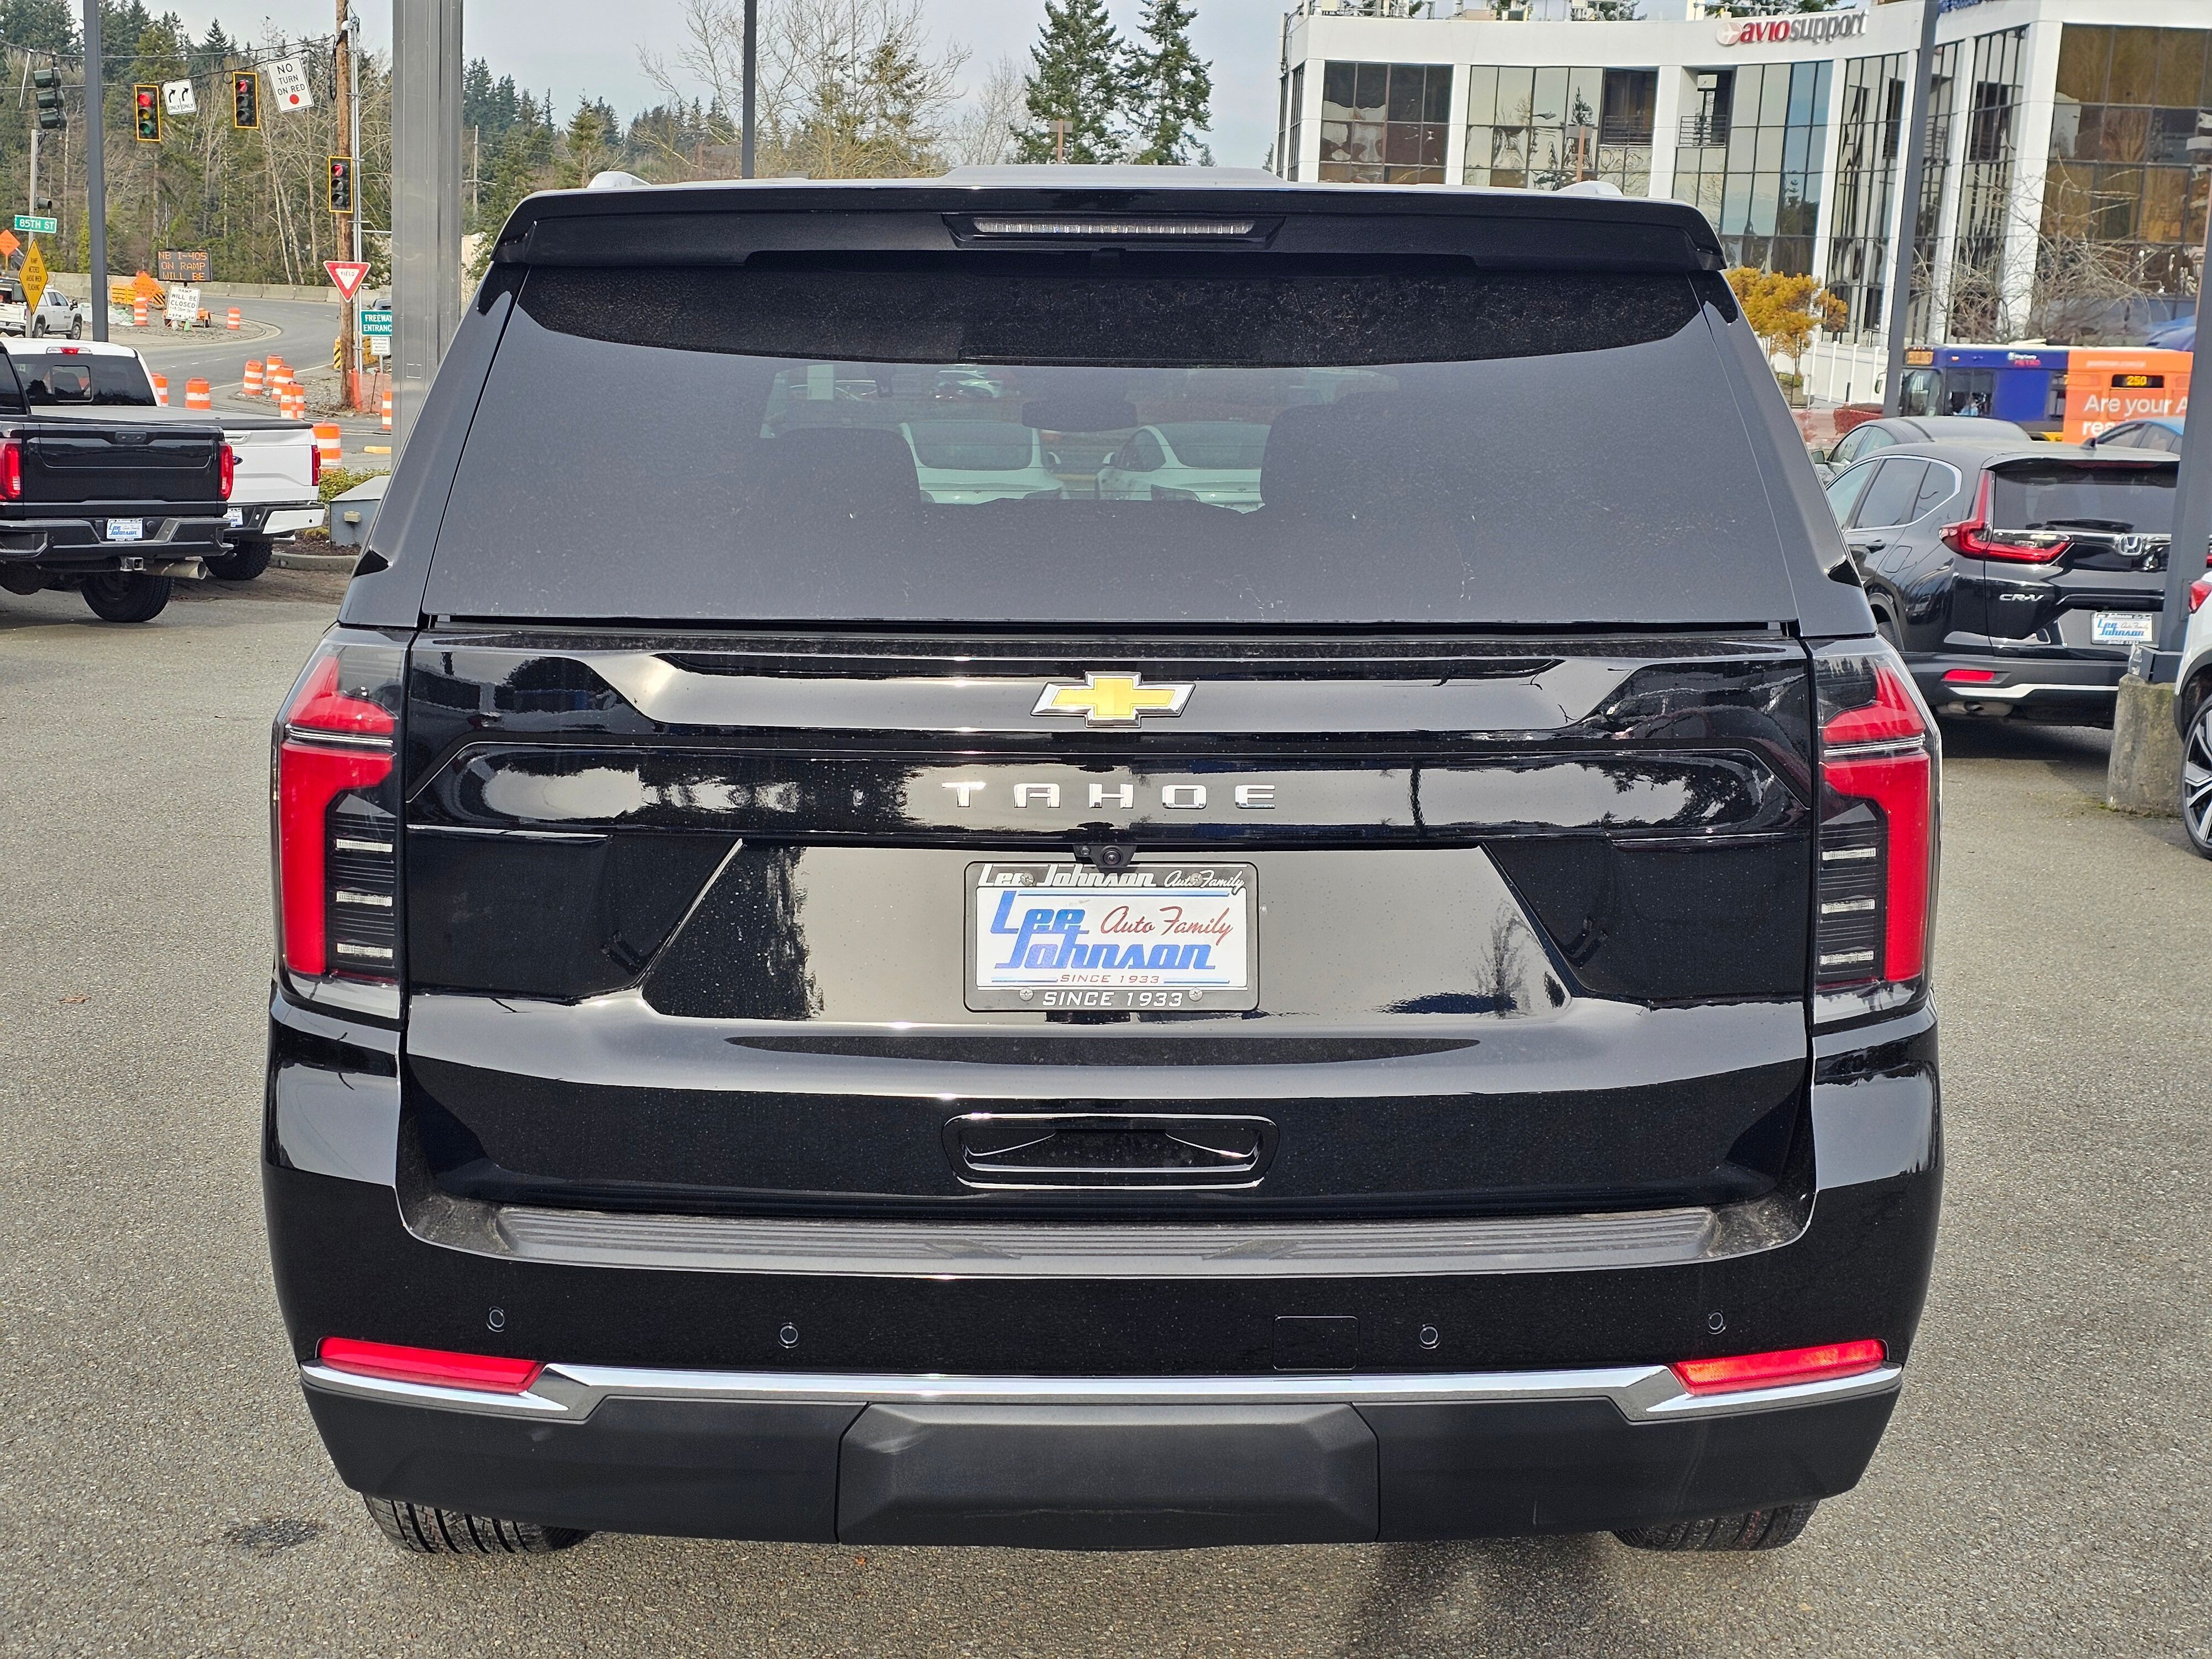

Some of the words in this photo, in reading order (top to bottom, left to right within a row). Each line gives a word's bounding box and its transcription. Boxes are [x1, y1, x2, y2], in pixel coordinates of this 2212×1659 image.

[277, 63, 293, 75] NO
[279, 75, 299, 85] TURN
[278, 87, 288, 96] ON
[291, 84, 305, 93] RED
[19, 219, 41, 229] 85TH
[44, 221, 55, 230] ST
[158, 251, 171, 259] NB
[178, 252, 207, 260] I-405
[161, 262, 174, 270] ON
[181, 262, 205, 270] RAMP
[163, 272, 186, 280] WILL
[192, 273, 205, 281] BE
[171, 300, 195, 308] CLOSED
[365, 314, 392, 322] FREEWAY
[2127, 375, 2147, 385] 250
[2084, 394, 2121, 413] Are
[2124, 397, 2173, 417] your
[2176, 395, 2188, 414] A
[2082, 419, 2118, 436] rea
[1999, 593, 2044, 602] CR-V
[2098, 618, 2117, 628] Lee
[2098, 627, 2145, 636] Johnson
[942, 781, 1275, 809] TAHOE
[1036, 864, 1157, 887] Johnson
[1164, 870, 1202, 888] Aut
[1198, 869, 1245, 895] Family
[990, 890, 1089, 934] Lee
[1100, 906, 1155, 934] Auto
[1160, 906, 1234, 946] Family
[995, 931, 1215, 969] Johnson
[1060, 974, 1112, 983] SINCE
[1119, 975, 1160, 983] 1933
[1042, 992, 1115, 1006] SINCE
[1126, 992, 1183, 1007] 1933
